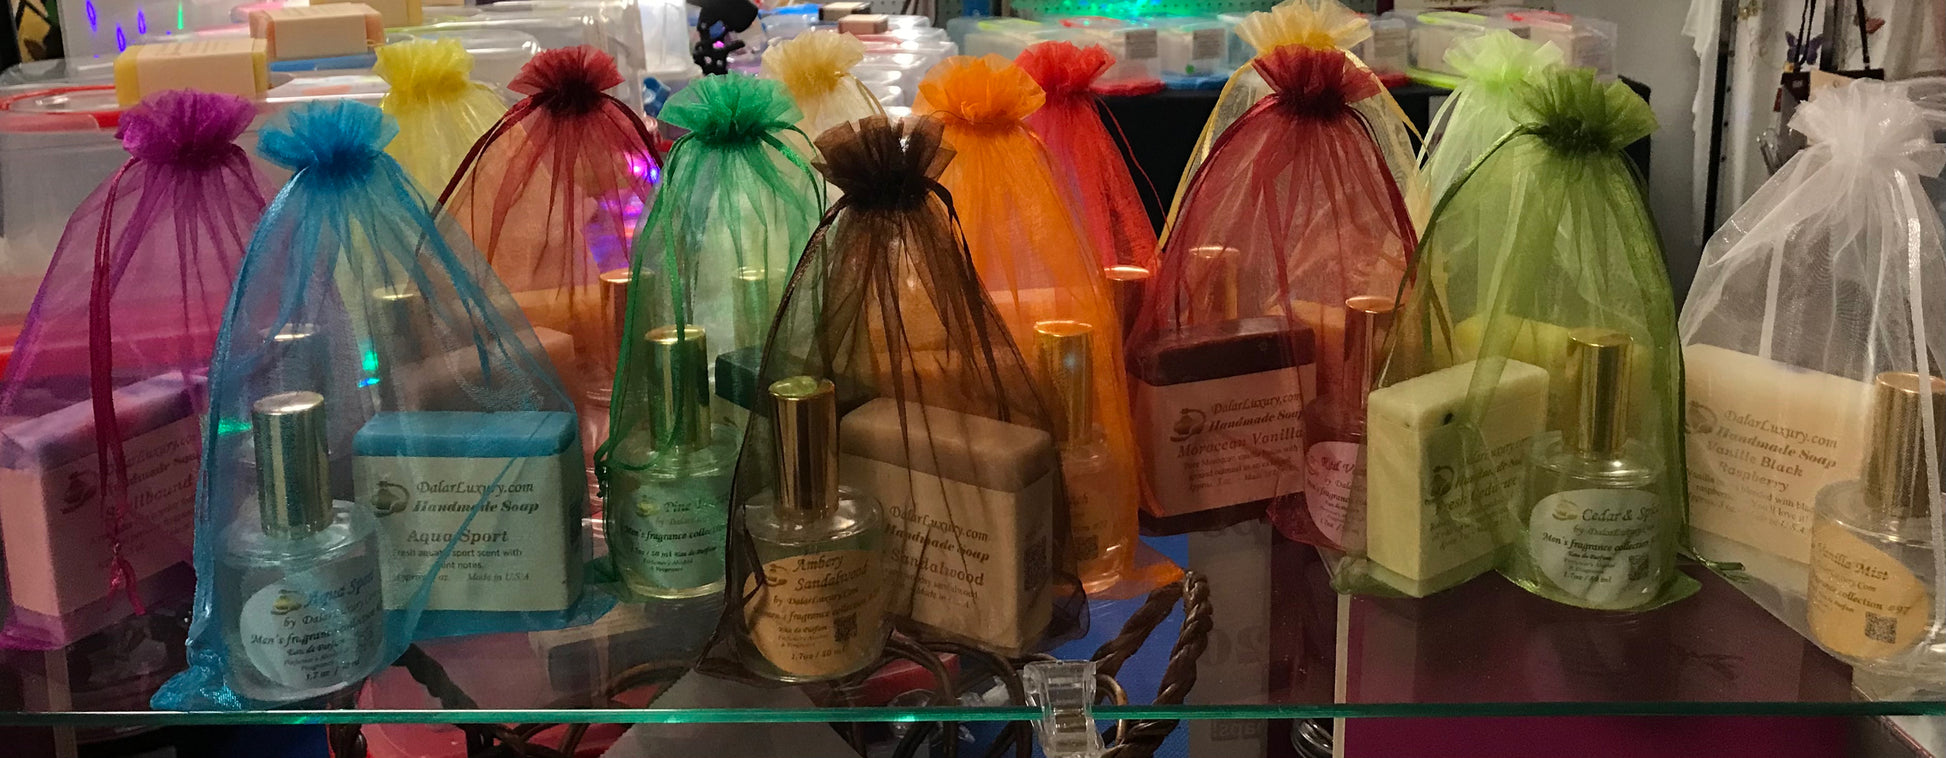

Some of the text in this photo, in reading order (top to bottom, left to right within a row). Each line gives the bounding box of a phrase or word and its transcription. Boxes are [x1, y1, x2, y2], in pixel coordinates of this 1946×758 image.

[1208, 411, 1275, 432] Handmade
[1723, 410, 1838, 448] DalarLuxury.com
[1177, 439, 1247, 458] Moroccan
[1715, 426, 1837, 470] Handmade Soap
[1719, 461, 1790, 493] Raspberry
[1760, 456, 1804, 478] Black
[500, 499, 540, 515] Soap
[1581, 508, 1622, 522] Cedar
[1622, 508, 1633, 521] &
[889, 505, 990, 543] DalarLuxury.com
[406, 528, 509, 545] Aqua Sport
[1542, 532, 1568, 546] Men's
[1567, 539, 1613, 553] fragrance
[452, 550, 476, 560] sport
[477, 549, 500, 558] scent
[502, 549, 523, 558] with
[791, 554, 845, 573] Ambery
[794, 558, 869, 592] Sandalwood
[890, 549, 985, 587] Sandalwood
[1854, 561, 1889, 581] Mist
[284, 615, 298, 629] by
